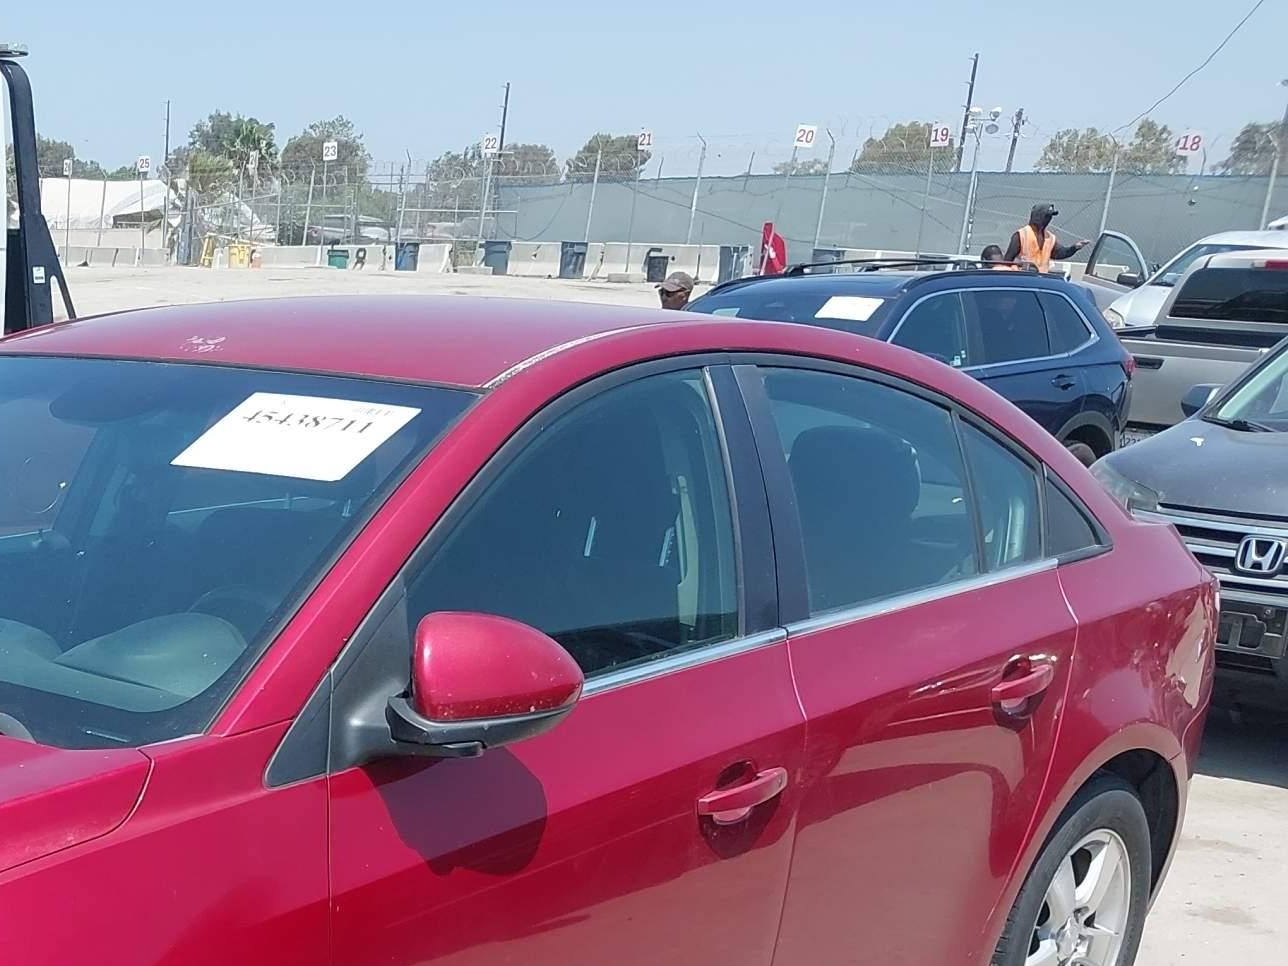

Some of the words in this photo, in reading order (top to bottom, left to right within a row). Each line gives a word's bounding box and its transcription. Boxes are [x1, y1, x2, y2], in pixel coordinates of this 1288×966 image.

[638, 133, 653, 147] 21
[797, 129, 815, 144] 20
[931, 127, 949, 143] 19
[484, 138, 498, 150] 22
[1178, 135, 1202, 151] 18
[242, 410, 374, 433] 45438711
